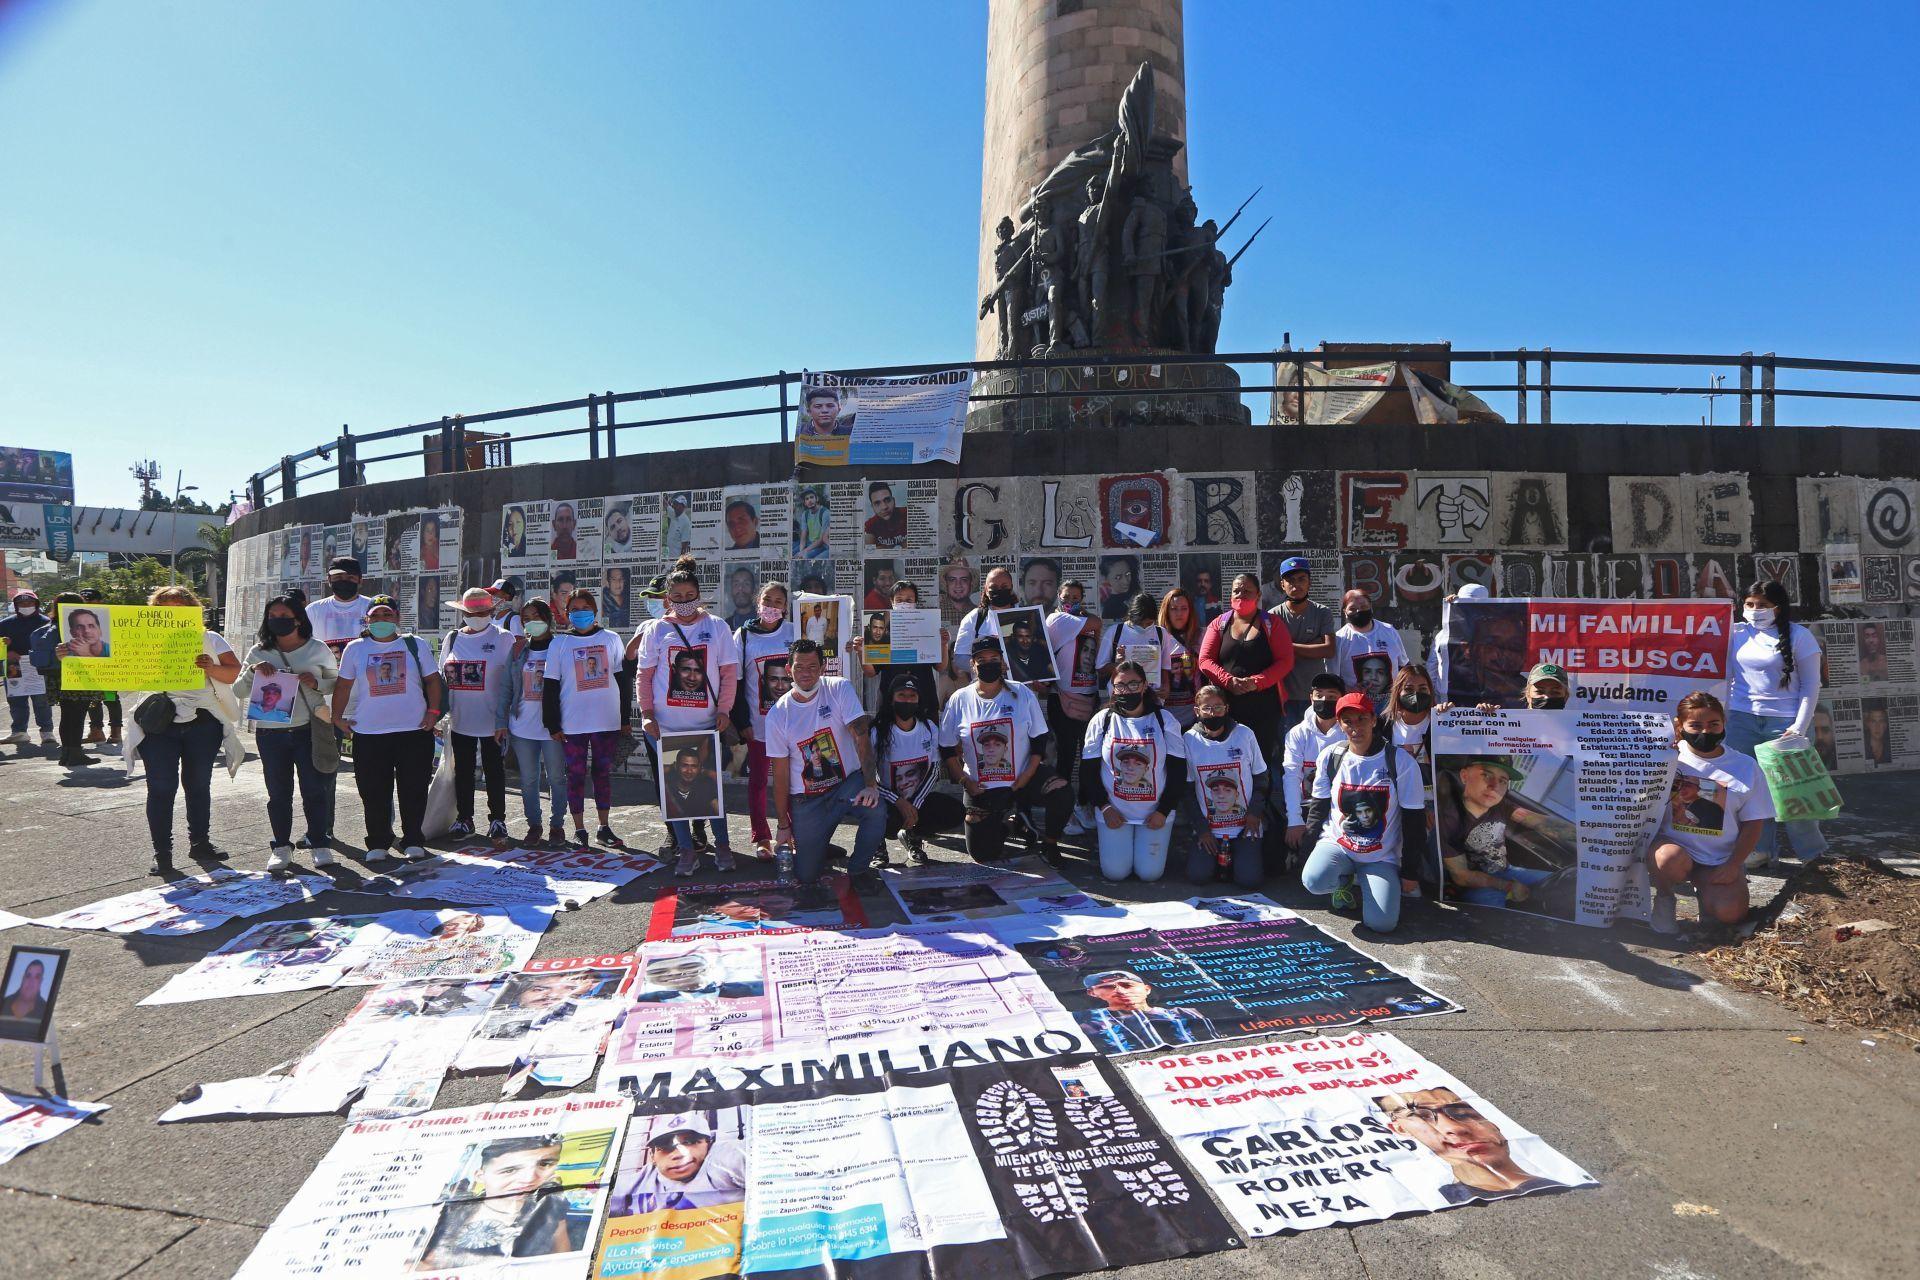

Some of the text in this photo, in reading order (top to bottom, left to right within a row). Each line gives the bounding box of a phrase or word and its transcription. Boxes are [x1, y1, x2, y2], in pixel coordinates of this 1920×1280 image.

[804, 370, 968, 387] TE ESTAMOS BUSCANDO
[137, 610, 173, 620] IGNACIO
[113, 618, 196, 629] LOPEZ CARDENAS
[1530, 613, 1722, 636] MI FAMILIA
[147, 629, 165, 639] has
[167, 630, 198, 640] visto?
[1539, 648, 1719, 673] ME BUSCA
[1576, 682, 1668, 703] ayúdame
[1621, 712, 1642, 720] José
[1438, 719, 1483, 728] regresar
[1508, 720, 1521, 728] mi
[1576, 720, 1665, 729] Jesús Silva
[1461, 728, 1498, 736] familia
[1577, 735, 1669, 744] Complexión: delgado
[1642, 744, 1668, 752] aprox
[1583, 759, 1668, 769] Señas particulares:
[1578, 777, 1639, 785] tatuados las
[1579, 785, 1589, 793] el
[1589, 785, 1617, 793] cuello
[1599, 794, 1631, 803] catrina
[1591, 803, 1604, 811] en
[1605, 803, 1614, 811] la
[1580, 820, 1631, 829] Expansores
[1588, 845, 1630, 856] de agosto
[1580, 861, 1589, 869] El
[1603, 864, 1615, 872] de
[1585, 891, 1615, 901] blanca
[1580, 899, 1605, 908] negra
[1087, 932, 1147, 944] Colectivo
[1316, 945, 1334, 953] de
[1213, 972, 1235, 981] en
[1239, 1006, 1392, 1032] Llama al 911 089
[638, 1041, 673, 1049] Estatura
[727, 1042, 743, 1051] KG
[1139, 1032, 1373, 1070] "DESAPARECIDO"
[617, 1029, 1082, 1101] MAXIMILIANO
[1164, 1064, 1279, 1093] ¿DONDE
[1171, 1093, 1213, 1109] "TE
[1213, 1083, 1306, 1108] ESTAMOS
[1201, 1115, 1392, 1160] CARLOS
[994, 1140, 1161, 1168] MIENTRAS NO TE ENTIERRE
[1216, 1137, 1420, 1175] MAXIMILIANO
[1012, 1152, 1156, 1178] TE SEGUIRE BUSCANDO
[1236, 1159, 1394, 1197] ROMERO
[799, 1194, 820, 1203] agosto
[780, 1205, 809, 1215] Zapopan,
[1256, 1195, 1370, 1220] MEZA
[610, 1213, 738, 1238] Persona desaparecida
[787, 1223, 827, 1234] cualquier
[607, 1240, 684, 1258] ¿Lo visto?
[751, 1240, 777, 1252] Sobre
[778, 1236, 787, 1246] la
[670, 1247, 732, 1265] encontrarlo
